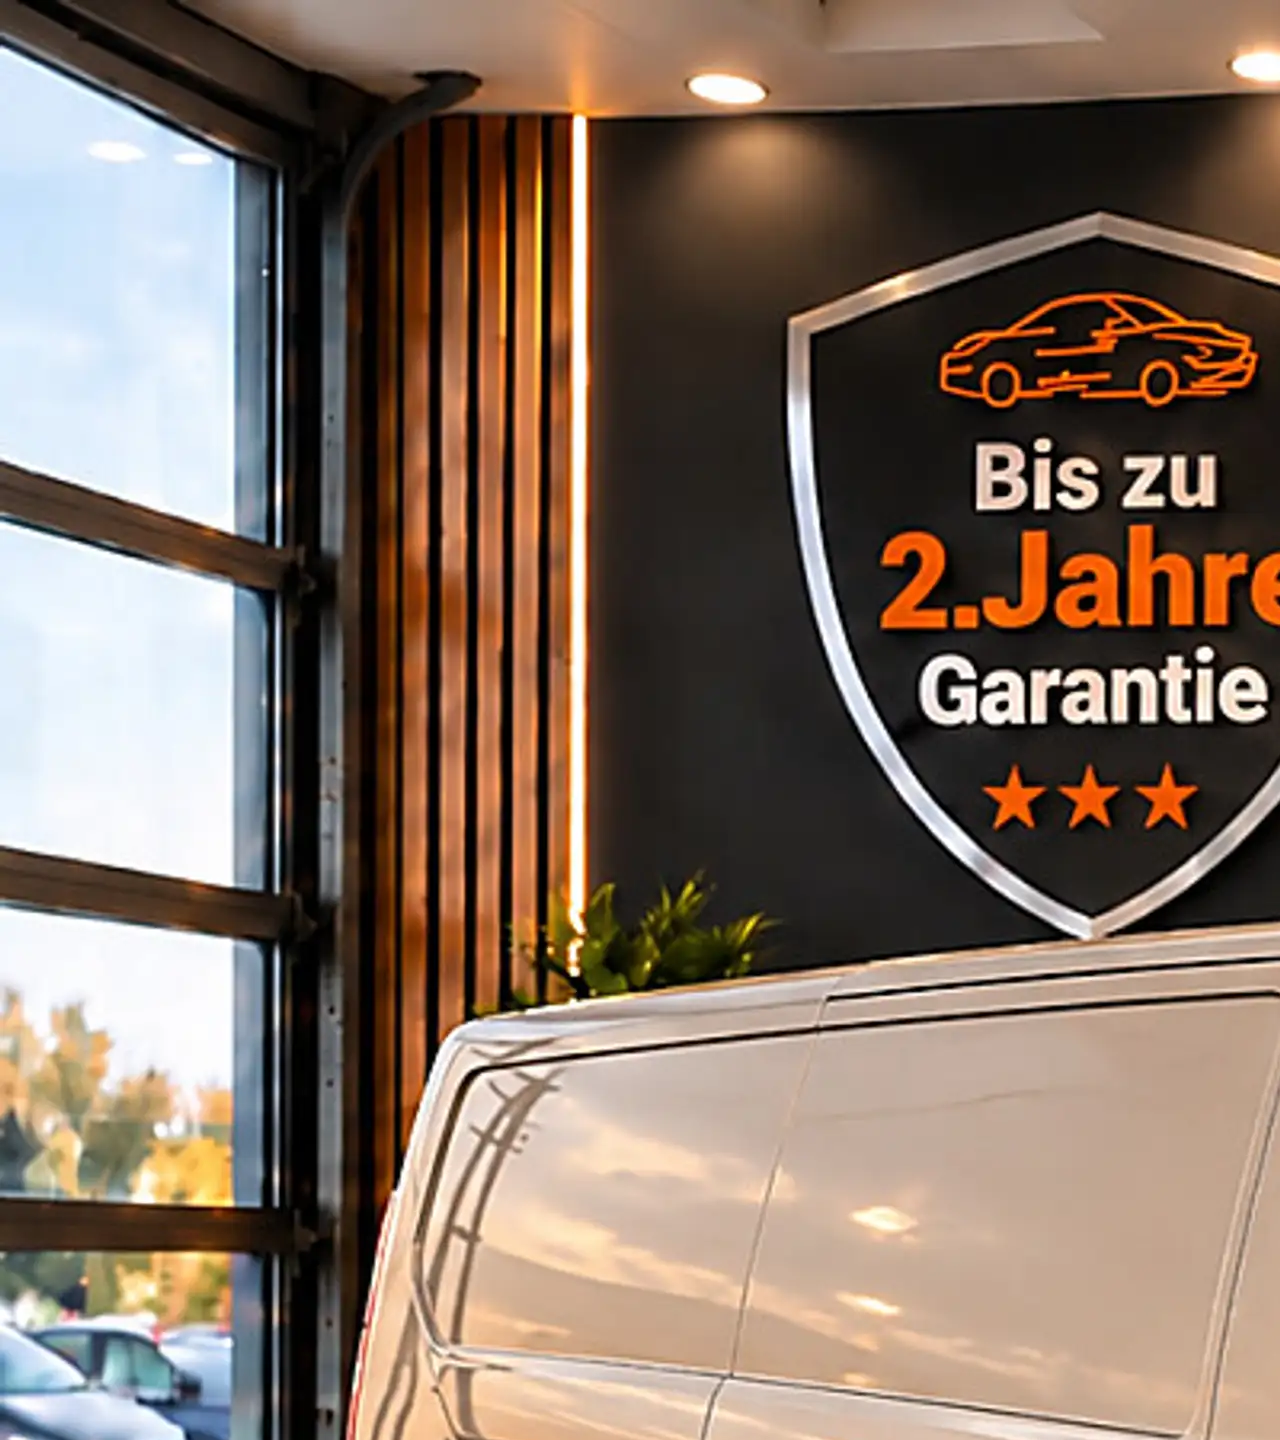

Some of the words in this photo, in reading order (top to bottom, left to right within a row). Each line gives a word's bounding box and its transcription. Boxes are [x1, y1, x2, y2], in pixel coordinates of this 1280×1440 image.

[975, 438, 1100, 511] Bis
[1122, 454, 1217, 509] zu
[918, 645, 1270, 726] Garantie
